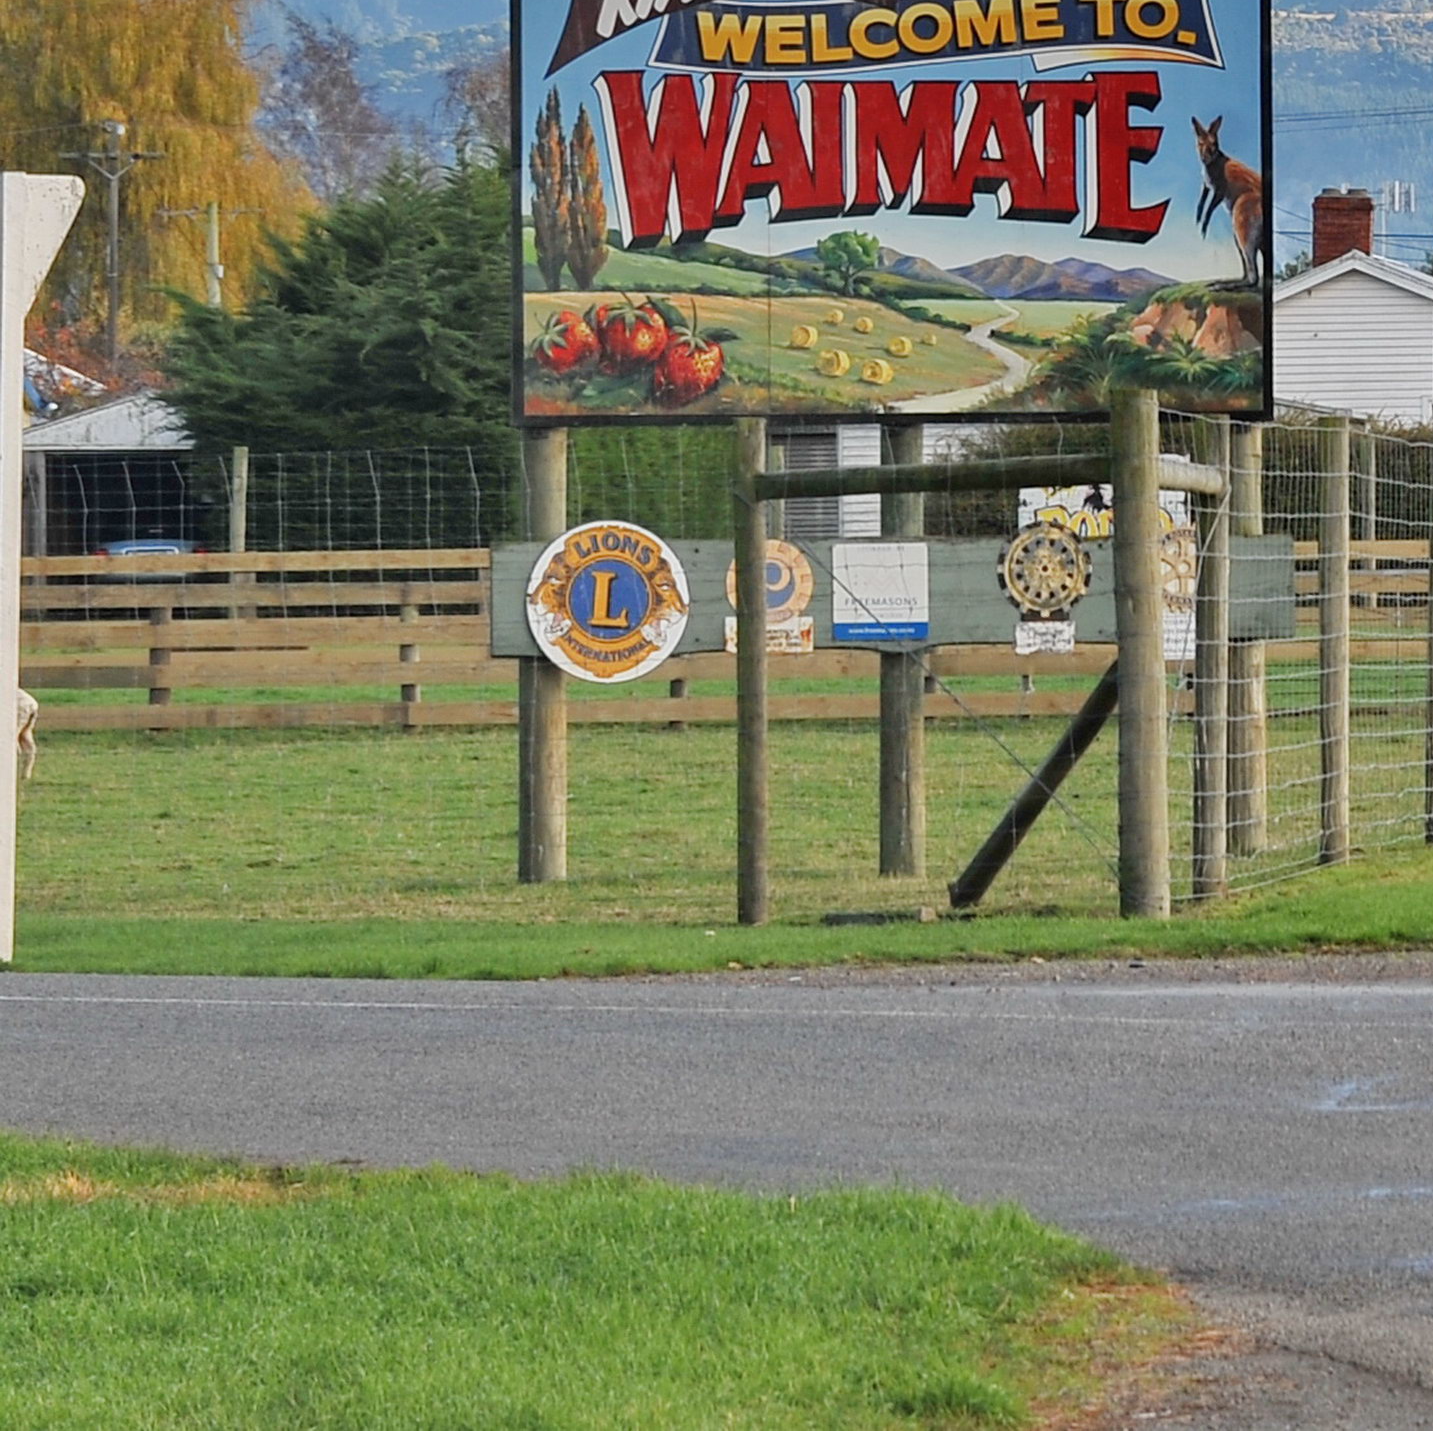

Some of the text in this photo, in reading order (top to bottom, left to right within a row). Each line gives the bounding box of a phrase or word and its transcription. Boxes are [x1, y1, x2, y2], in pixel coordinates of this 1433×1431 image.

[594, 70, 1171, 244] WAIMATE
[573, 531, 655, 567] LIONS
[588, 571, 629, 628] L
[565, 634, 652, 663] INTERNATIONAL
